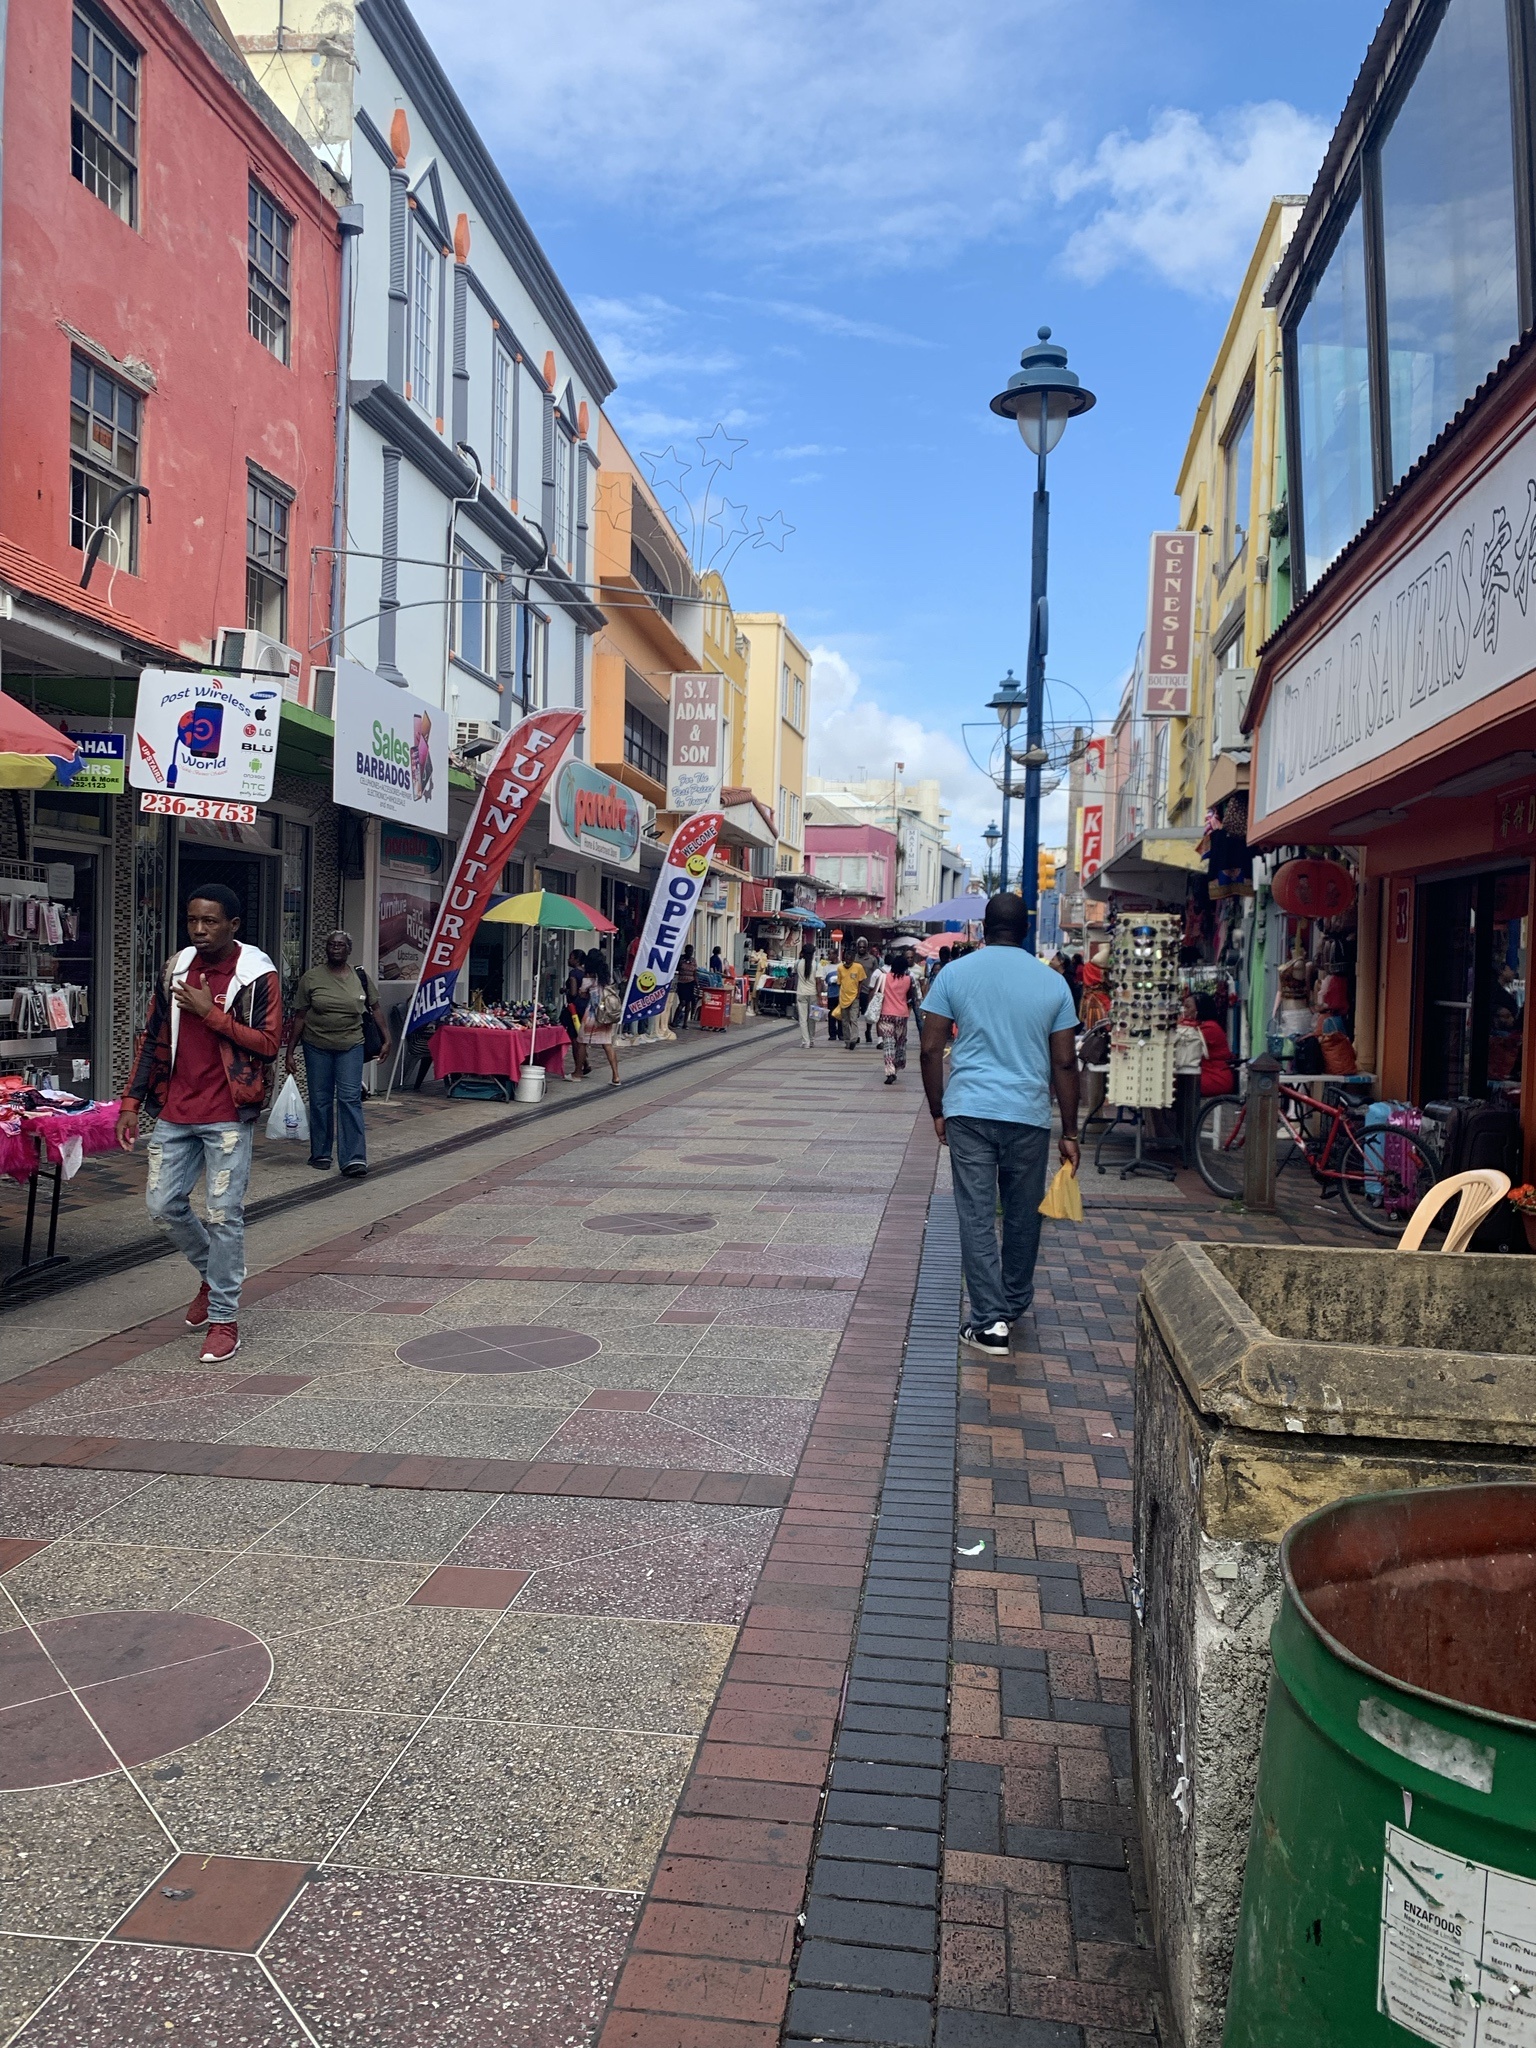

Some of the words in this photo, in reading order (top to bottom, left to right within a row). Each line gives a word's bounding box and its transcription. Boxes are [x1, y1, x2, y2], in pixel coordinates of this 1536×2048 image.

[1160, 539, 1185, 670] GENESIS
[1364, 522, 1475, 739] SAVERS
[684, 680, 710, 699] S.Y.
[1149, 676, 1188, 688] BOUTIQUE
[160, 687, 190, 708] Post
[195, 686, 251, 717] Wireless
[676, 702, 717, 721] ADAM
[259, 728, 272, 737] LG
[372, 720, 410, 767] Sales
[689, 724, 701, 741] &
[79, 764, 111, 775] IRS
[141, 745, 164, 783] UPSTAIRS
[181, 752, 227, 770] World
[680, 745, 710, 763] SON
[356, 752, 411, 790] BARBADOS
[142, 793, 254, 823] 236-3753
[430, 728, 556, 968] FURNITURE
[681, 825, 718, 858] WELCOME
[908, 830, 916, 870] MAXIMUM
[406, 914, 431, 949] Rugs
[646, 877, 695, 973] OPEN
[412, 976, 450, 1022] SALE
[629, 986, 666, 1014] WELCOME
[1403, 1899, 1463, 1937] ENZAFOODS
[1403, 1913, 1416, 1923] New
[1416, 1919, 1439, 1935] Zealand
[1391, 1995, 1416, 2012] Another
[1416, 2010, 1439, 2025] quality
[1439, 2023, 1466, 2037] product
[1415, 2016, 1456, 2040] ENZAFOODS
